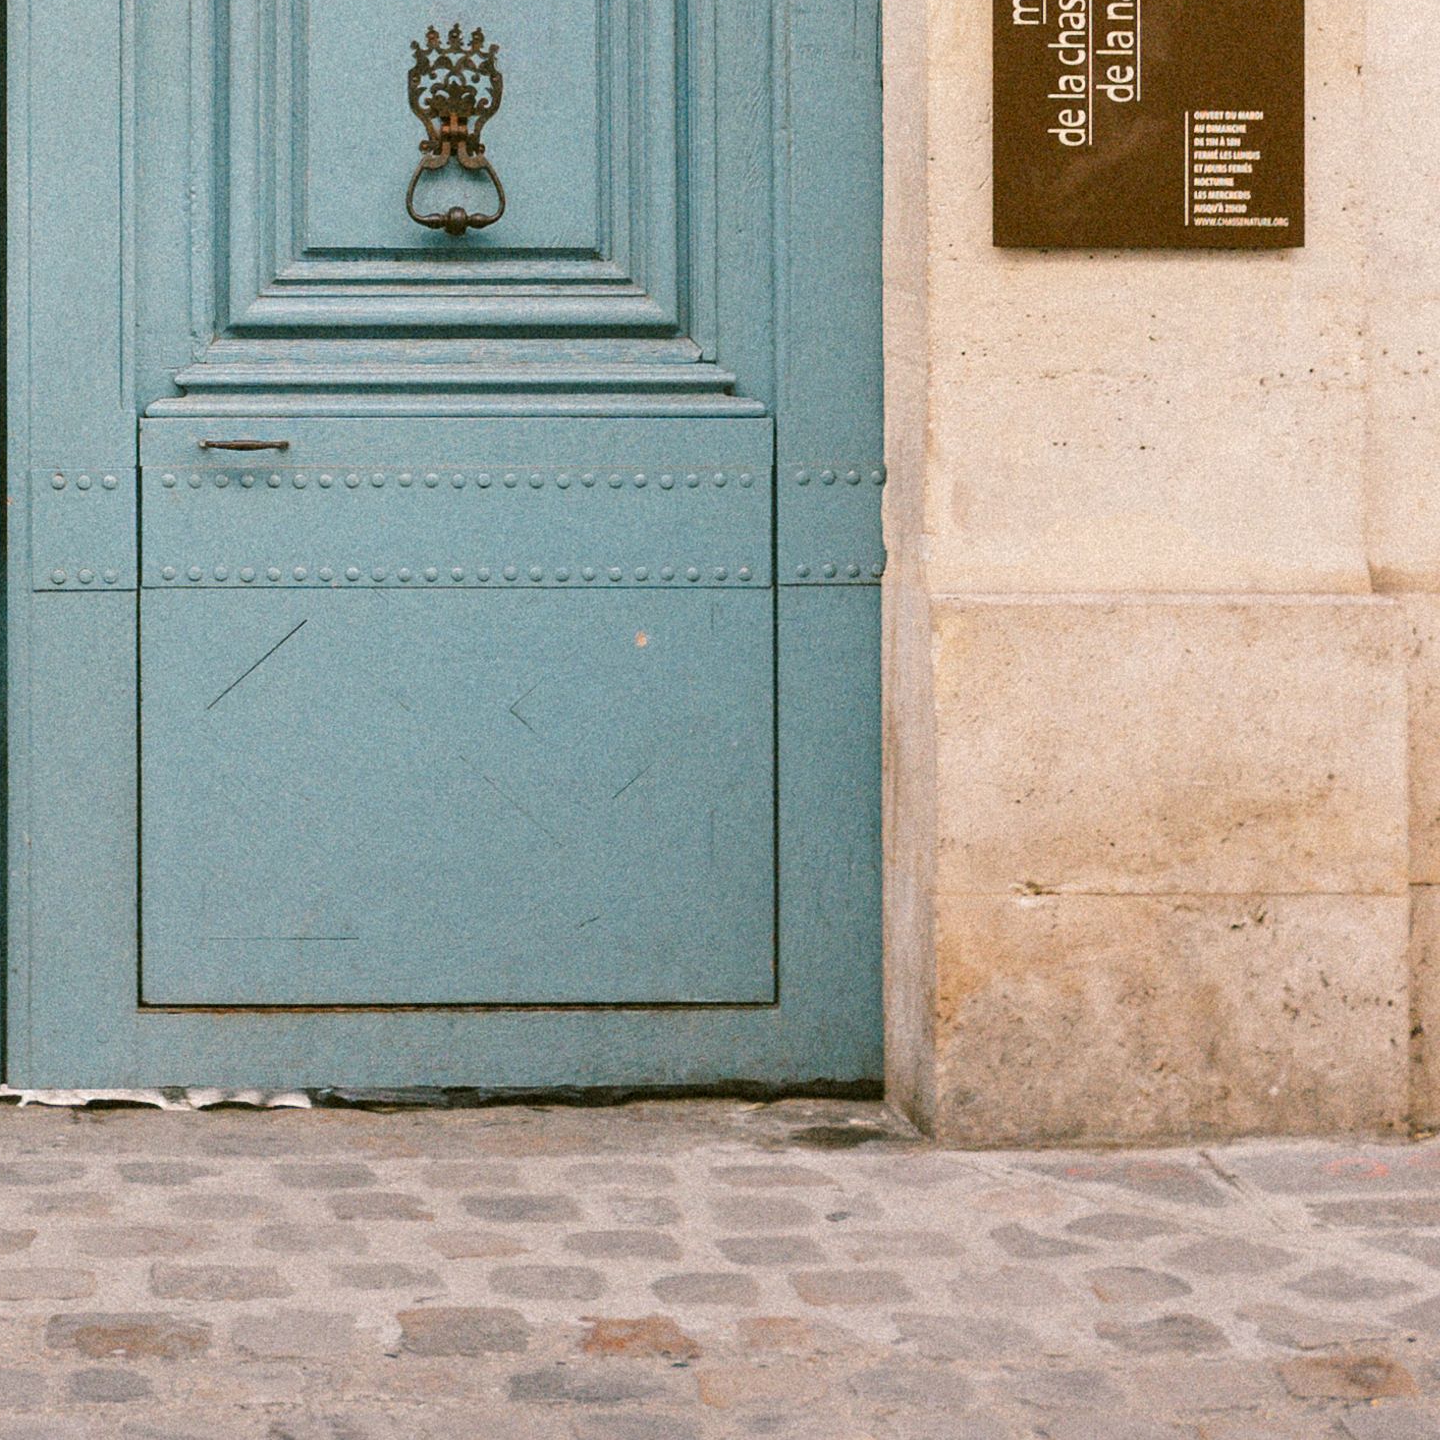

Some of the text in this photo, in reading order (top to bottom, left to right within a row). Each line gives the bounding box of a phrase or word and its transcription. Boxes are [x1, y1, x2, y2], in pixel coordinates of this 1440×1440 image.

[1095, 30, 1135, 55] la
[1047, 74, 1087, 99] la
[1095, 65, 1135, 103] de
[1193, 110, 1224, 121] OUVERT
[1224, 110, 1238, 121] DU
[1047, 108, 1087, 147] de
[1193, 123, 1206, 134] AU
[1193, 137, 1205, 147] DE
[1218, 150, 1233, 160] LES
[1193, 163, 1204, 174] ET
[1193, 177, 1235, 187] NOCTURNE
[1193, 190, 1207, 200] LES
